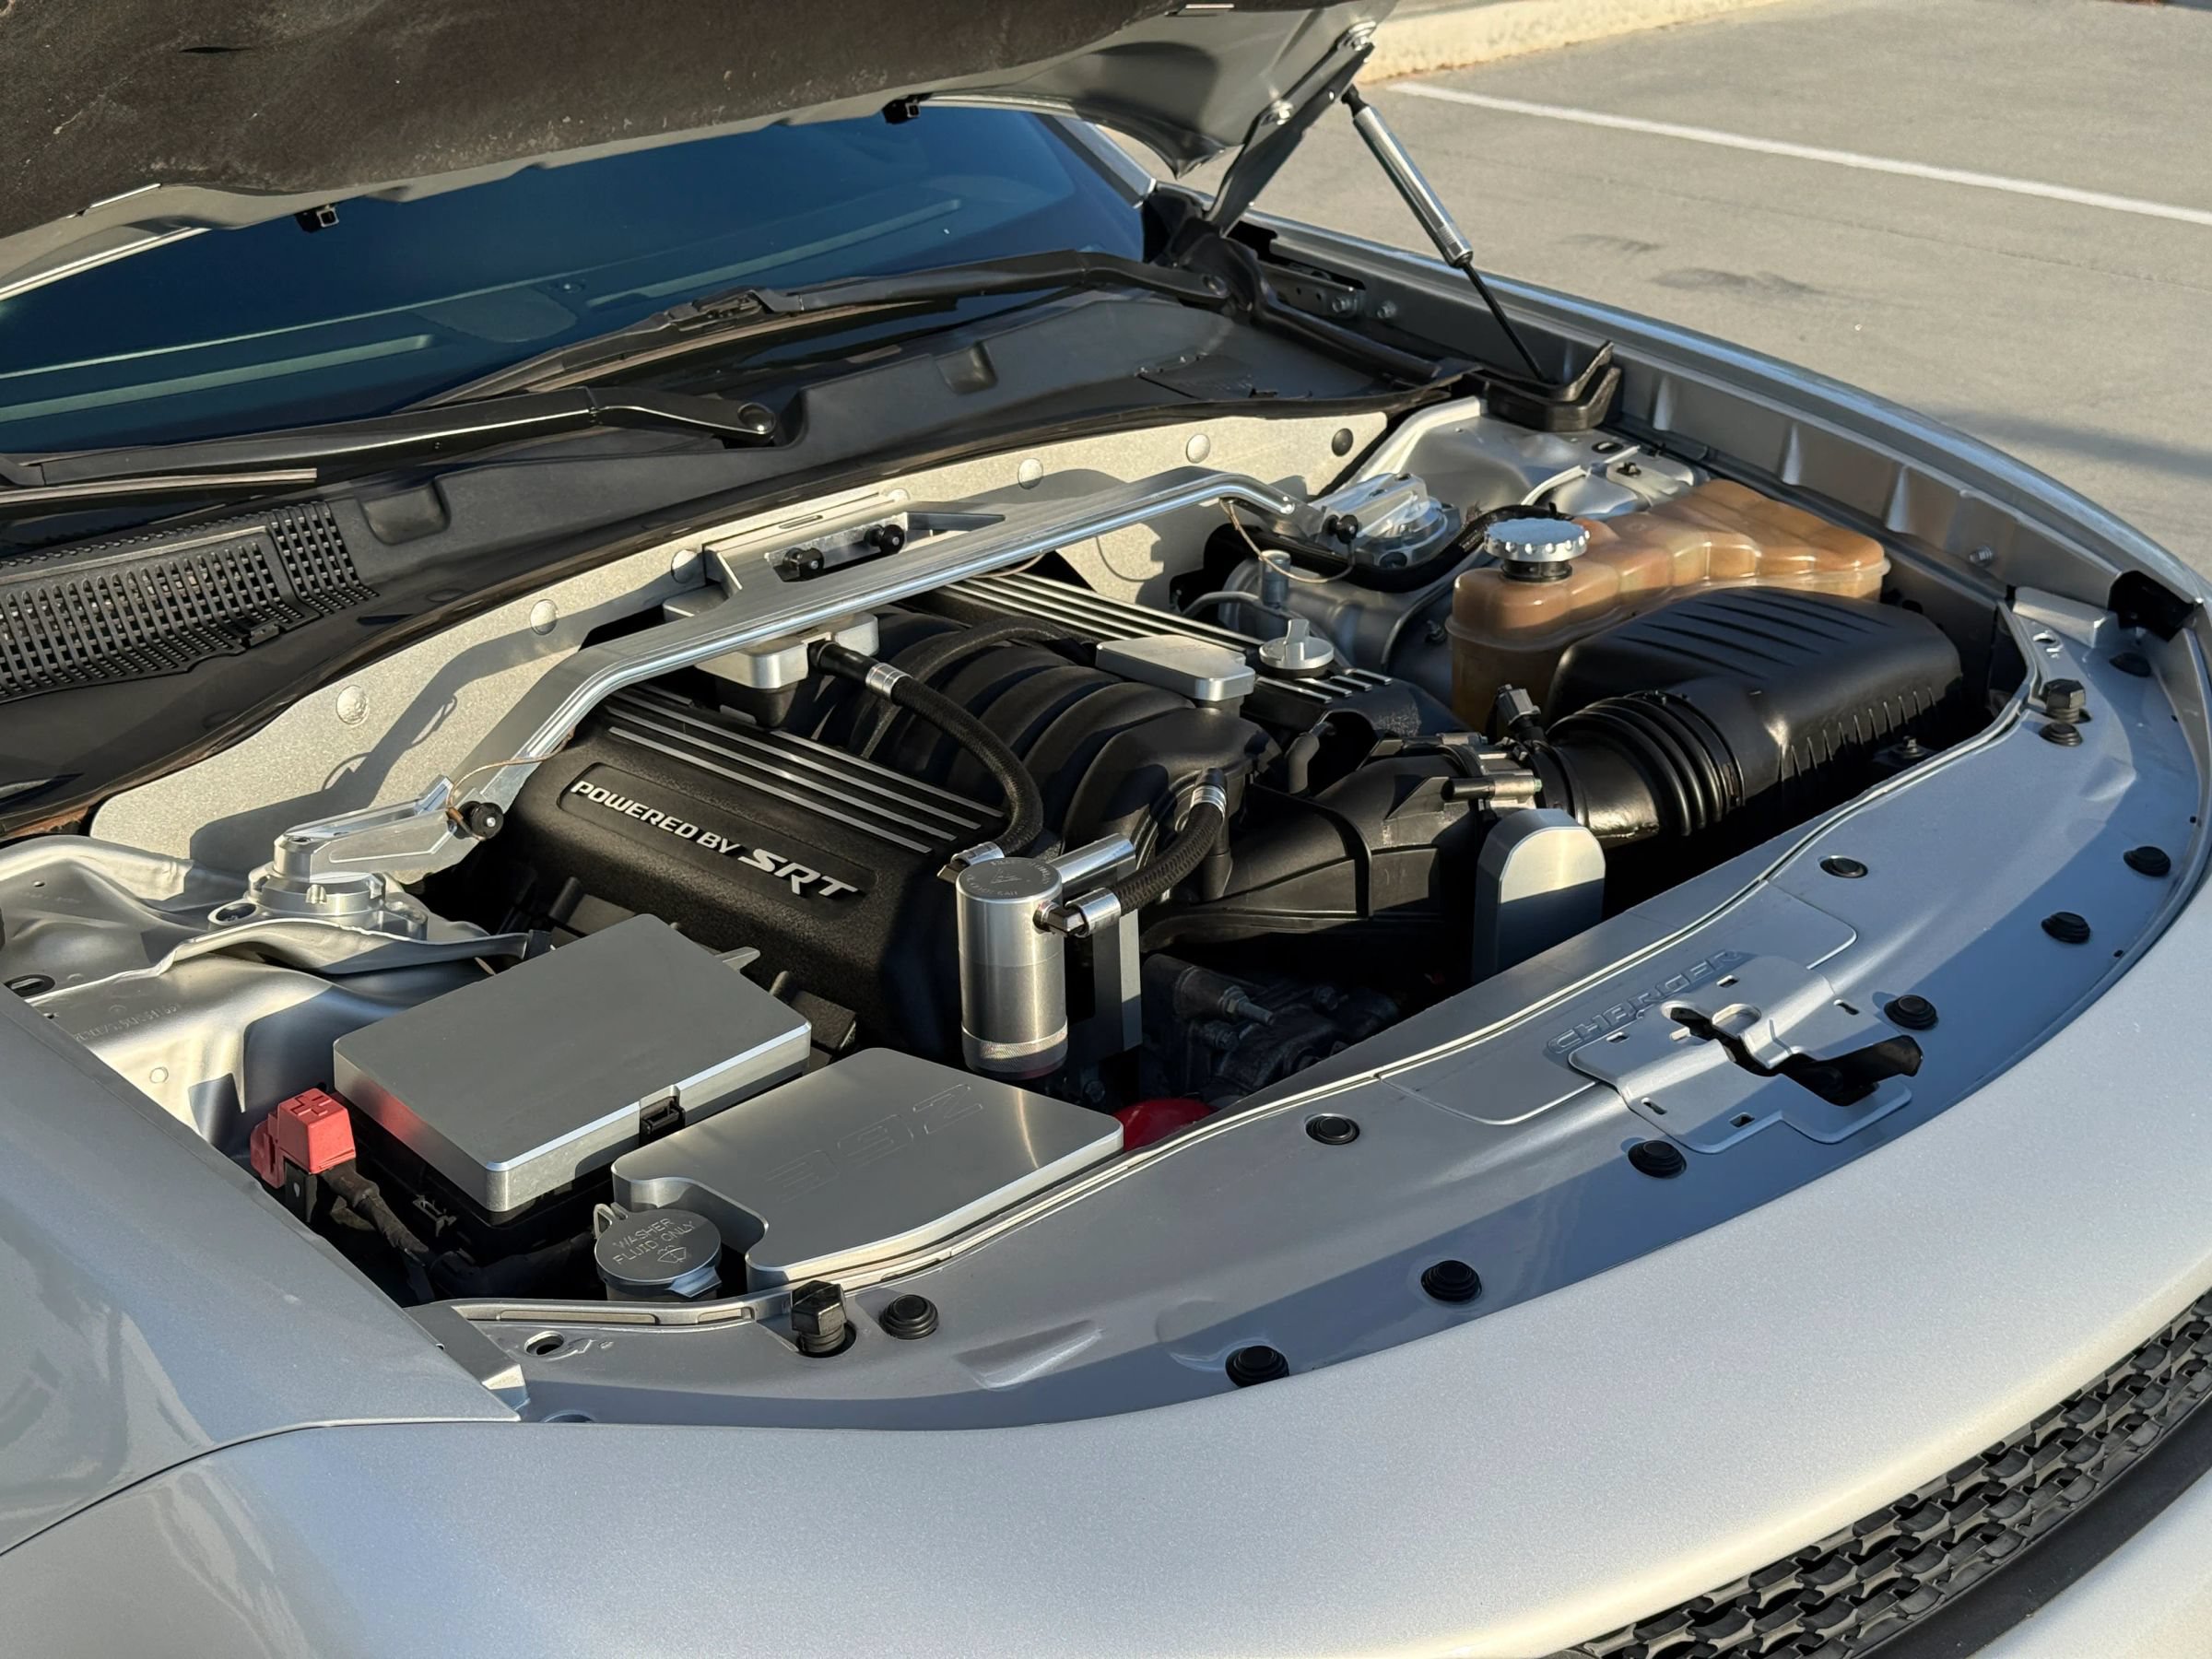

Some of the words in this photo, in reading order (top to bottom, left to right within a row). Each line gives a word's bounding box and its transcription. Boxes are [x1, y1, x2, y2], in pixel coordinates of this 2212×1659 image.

[571, 780, 699, 840] POWERED
[697, 831, 741, 855] BY
[737, 848, 858, 896] SRT
[1547, 949, 1743, 1054] CHARGER
[763, 1083, 983, 1204] 392
[612, 1240, 660, 1265] FLUID
[660, 1220, 697, 1242] ONLY
[613, 1218, 675, 1249] WASHER
